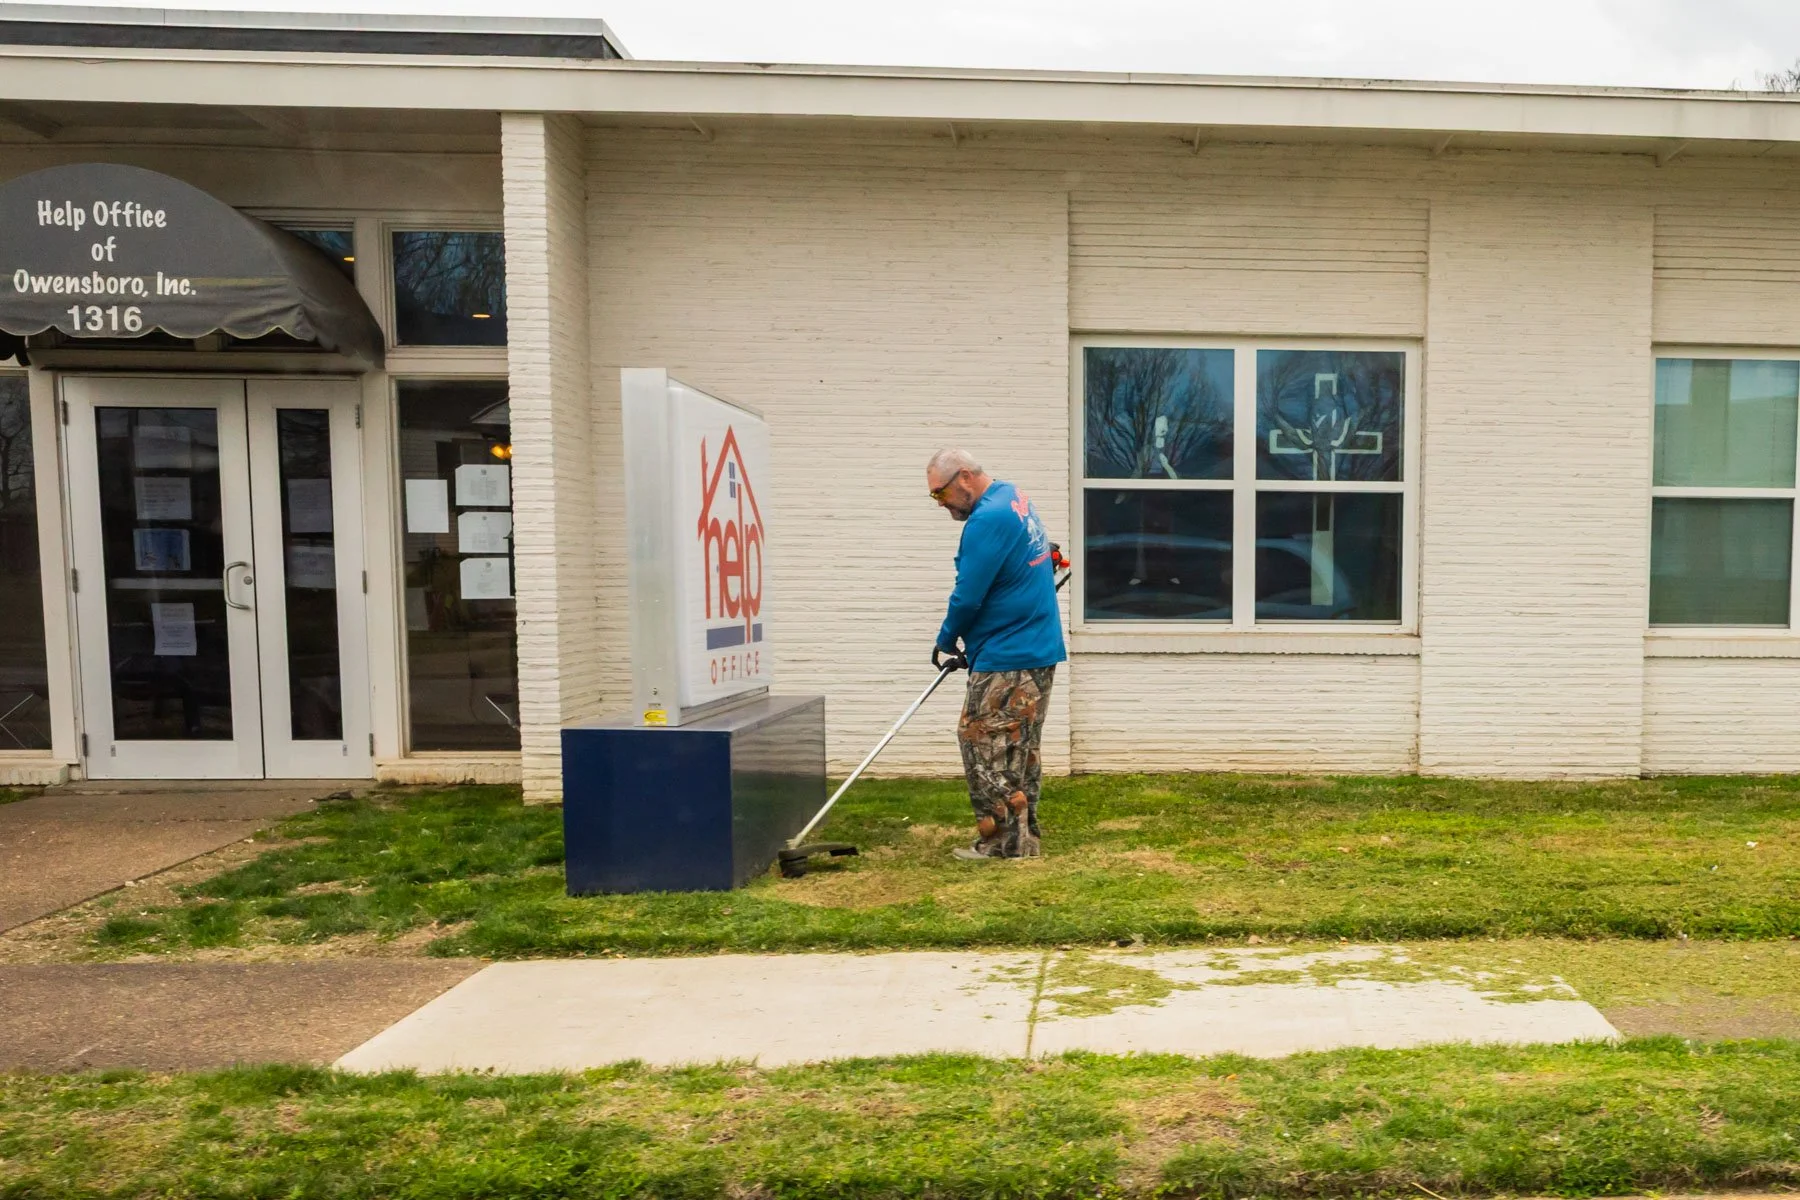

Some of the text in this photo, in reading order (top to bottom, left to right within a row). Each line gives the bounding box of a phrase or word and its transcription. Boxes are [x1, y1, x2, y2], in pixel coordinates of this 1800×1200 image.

[37, 200, 167, 231] Help Office
[91, 236, 116, 262] of
[13, 269, 197, 298] Owensboro, Inc.
[67, 305, 143, 332] 1316
[700, 434, 762, 644] help
[711, 651, 760, 685] OFFICE
